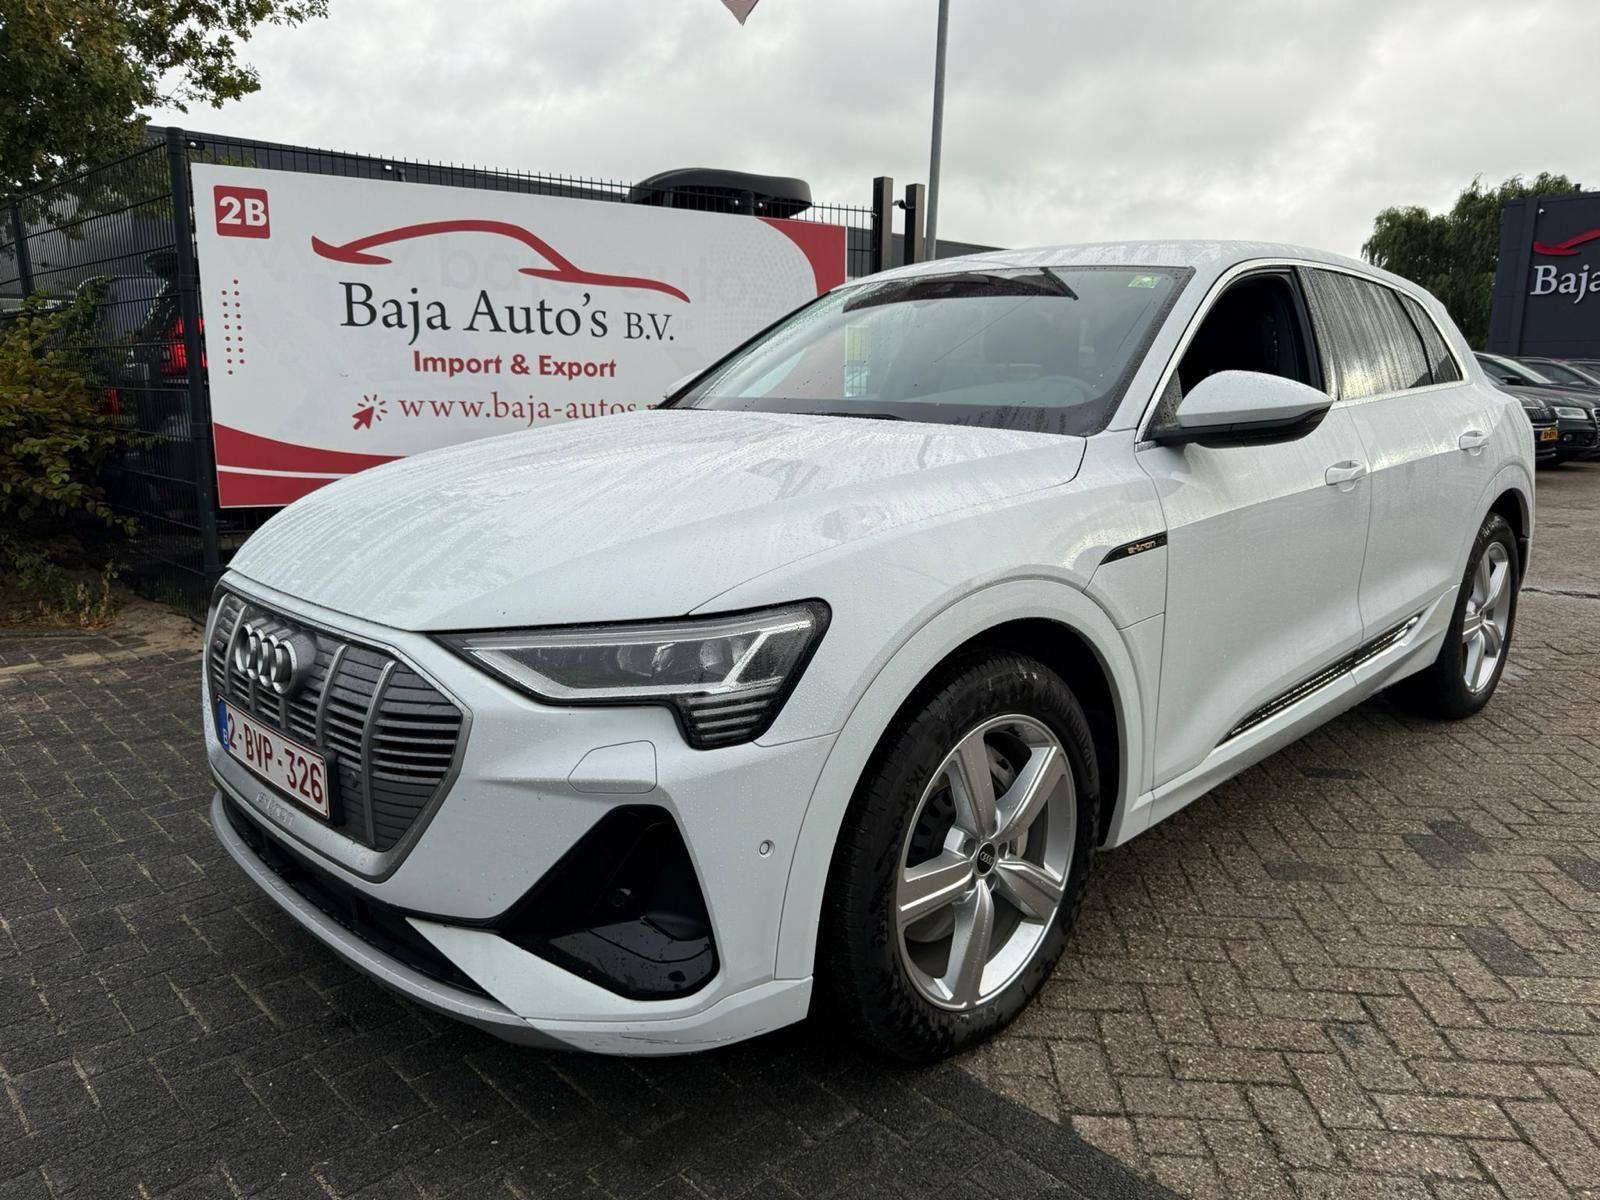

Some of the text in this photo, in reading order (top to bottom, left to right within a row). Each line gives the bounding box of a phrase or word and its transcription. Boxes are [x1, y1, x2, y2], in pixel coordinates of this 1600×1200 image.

[218, 194, 268, 229] 2B
[338, 281, 675, 346] Baja Auto's B.V.
[413, 350, 617, 381] Import & Export
[227, 711, 323, 805] 2-BVP-326
